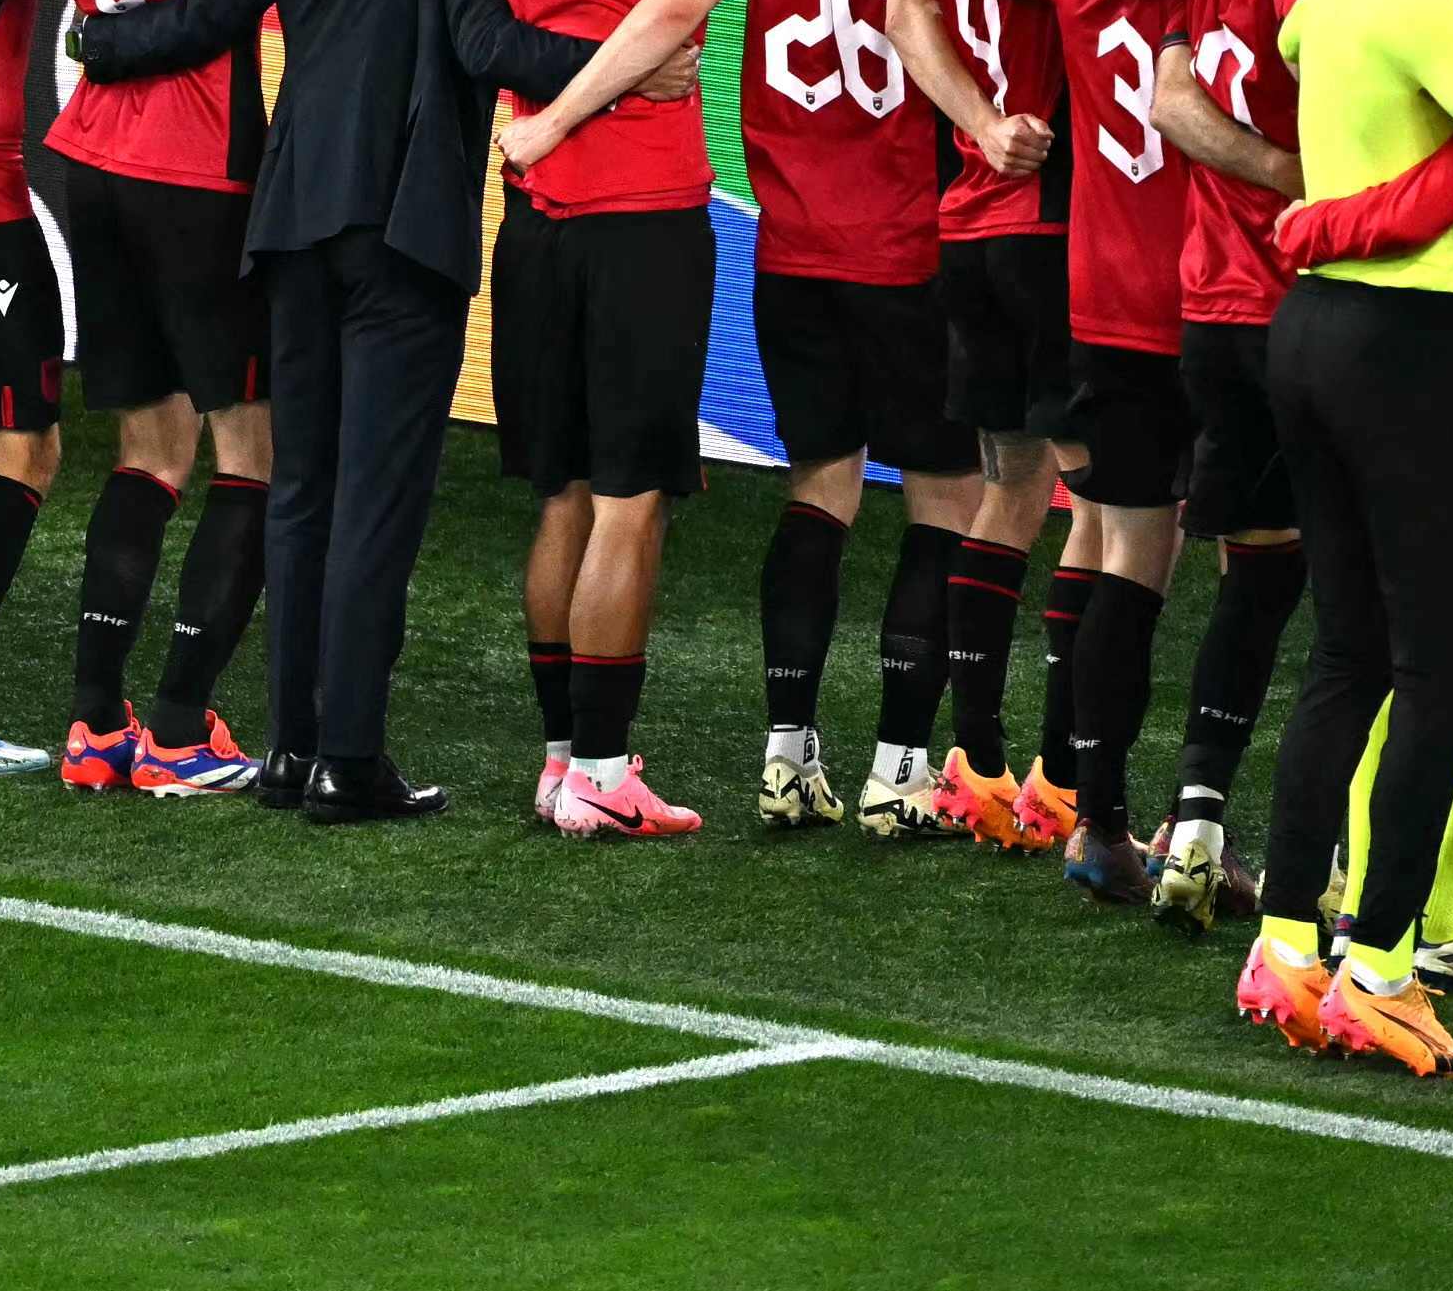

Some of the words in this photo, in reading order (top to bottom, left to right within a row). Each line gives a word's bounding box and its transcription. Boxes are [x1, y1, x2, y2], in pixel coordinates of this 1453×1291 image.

[1096, 15, 1165, 185] 3
[82, 612, 129, 627] FSHF
[766, 667, 808, 679] FSHF
